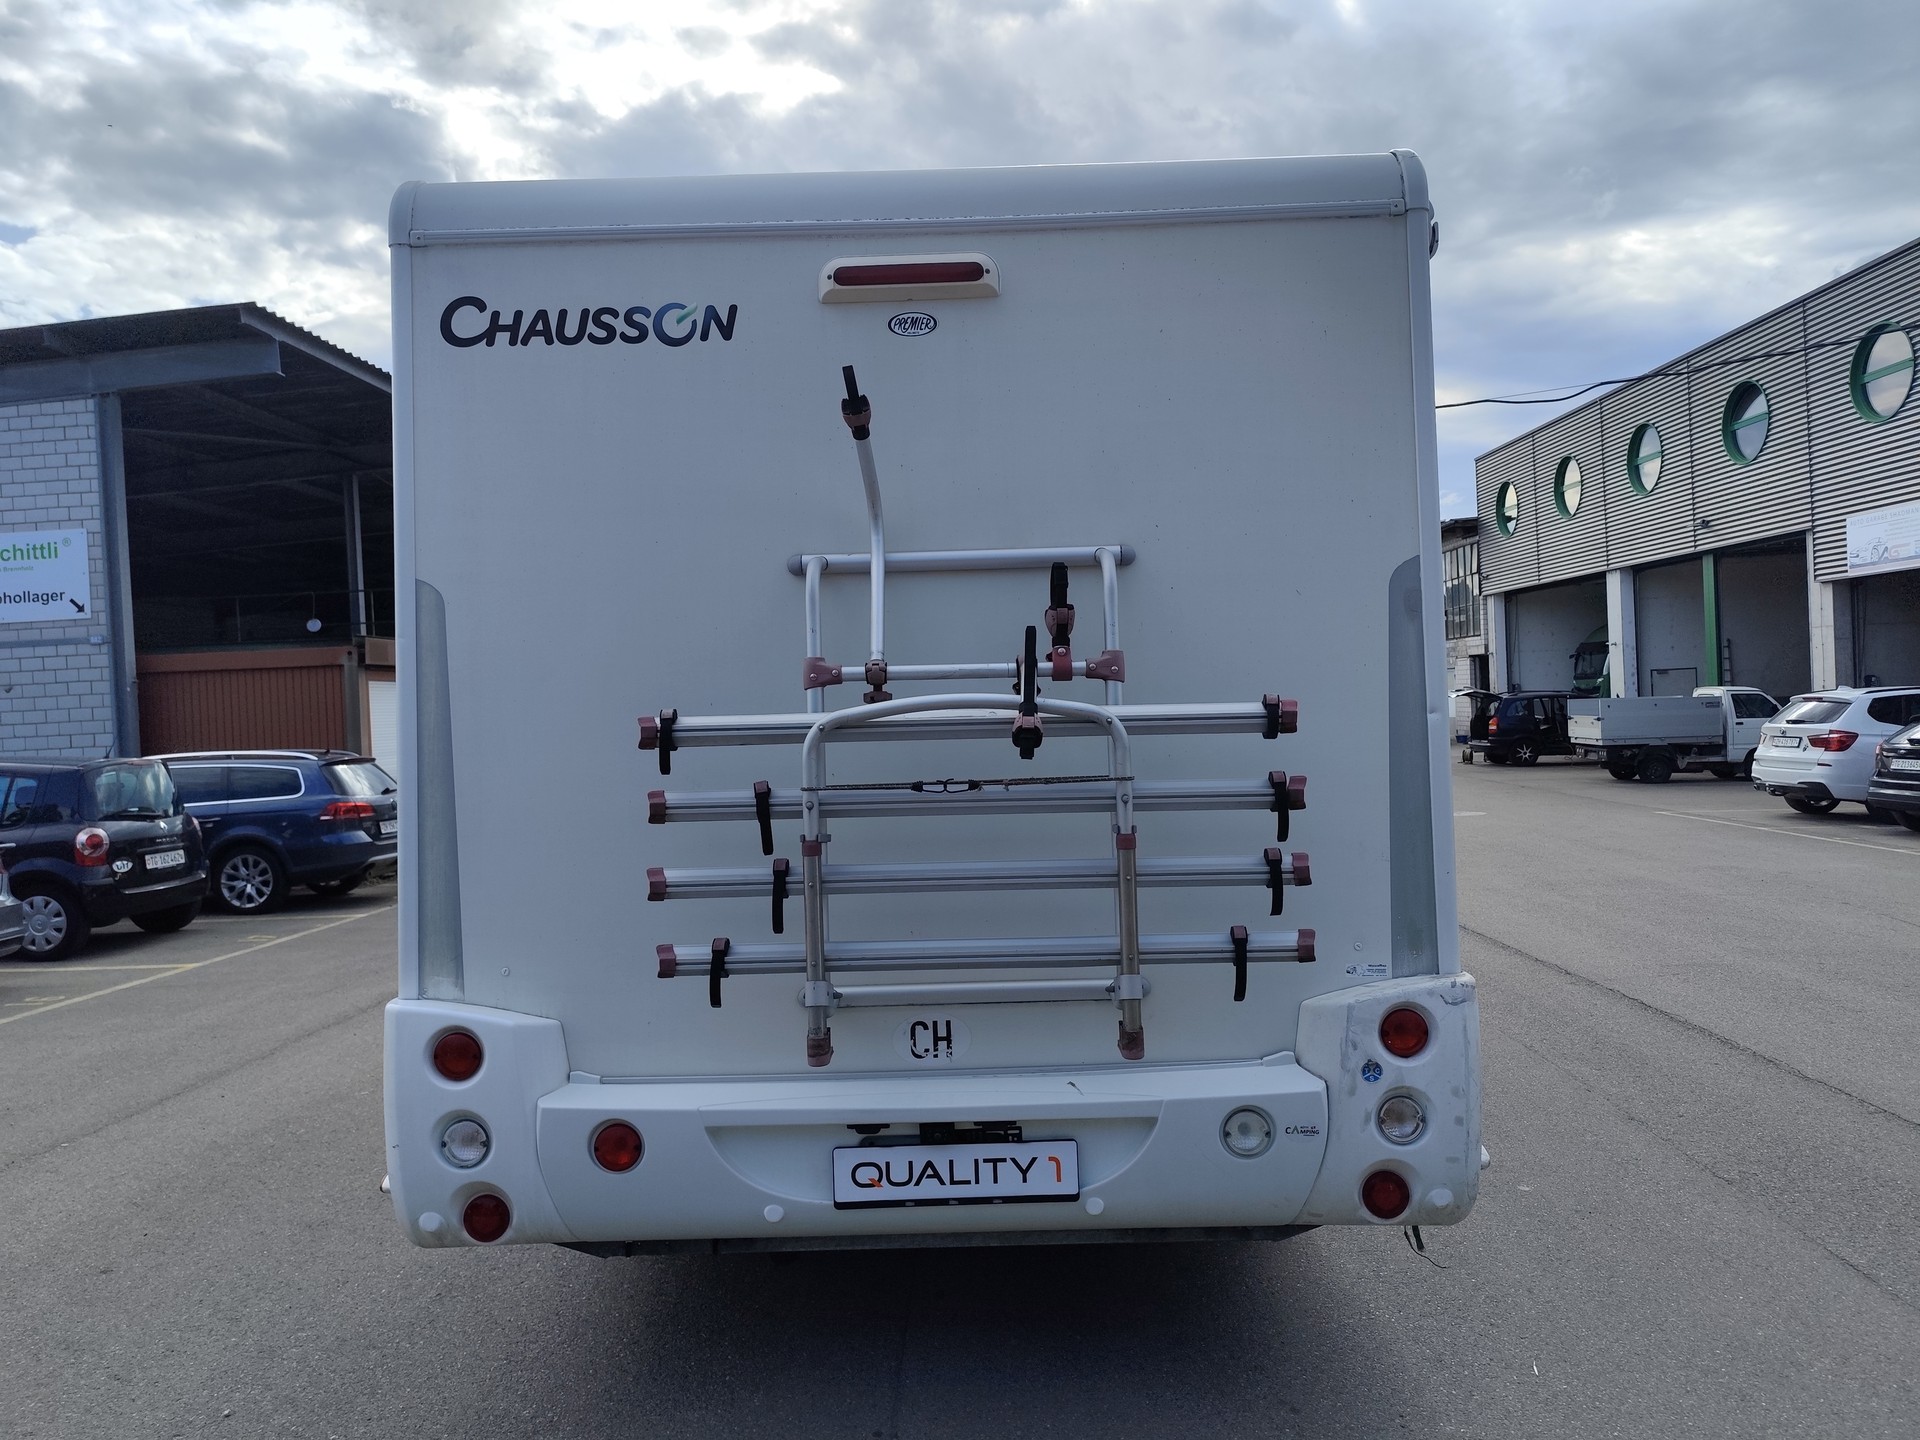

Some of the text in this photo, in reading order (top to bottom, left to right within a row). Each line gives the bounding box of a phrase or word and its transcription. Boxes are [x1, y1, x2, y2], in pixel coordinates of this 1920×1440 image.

[440, 296, 738, 348] CHAUSSON
[893, 316, 934, 333] PREMIER
[910, 1020, 953, 1059] CH
[851, 1156, 1062, 1189] QUALITY 1
